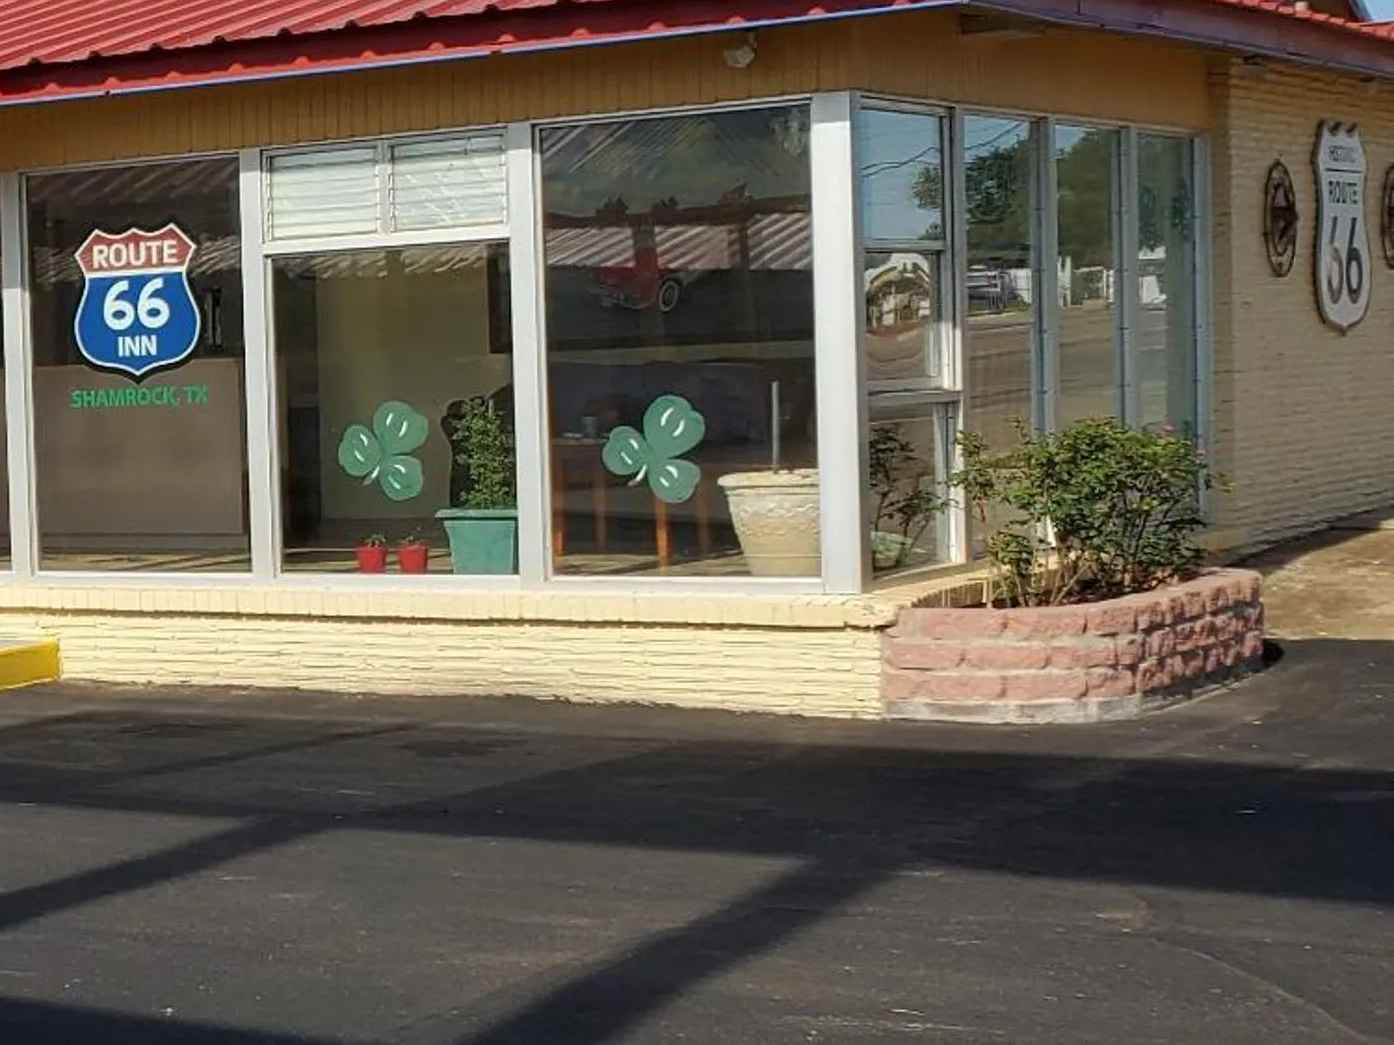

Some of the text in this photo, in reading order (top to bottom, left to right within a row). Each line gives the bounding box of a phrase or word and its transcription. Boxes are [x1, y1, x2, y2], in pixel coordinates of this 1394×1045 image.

[1328, 180, 1358, 204] ROUTE
[92, 240, 178, 269] ROUTE
[103, 277, 170, 330] 66
[118, 335, 157, 357] INN
[183, 384, 210, 405] TX
